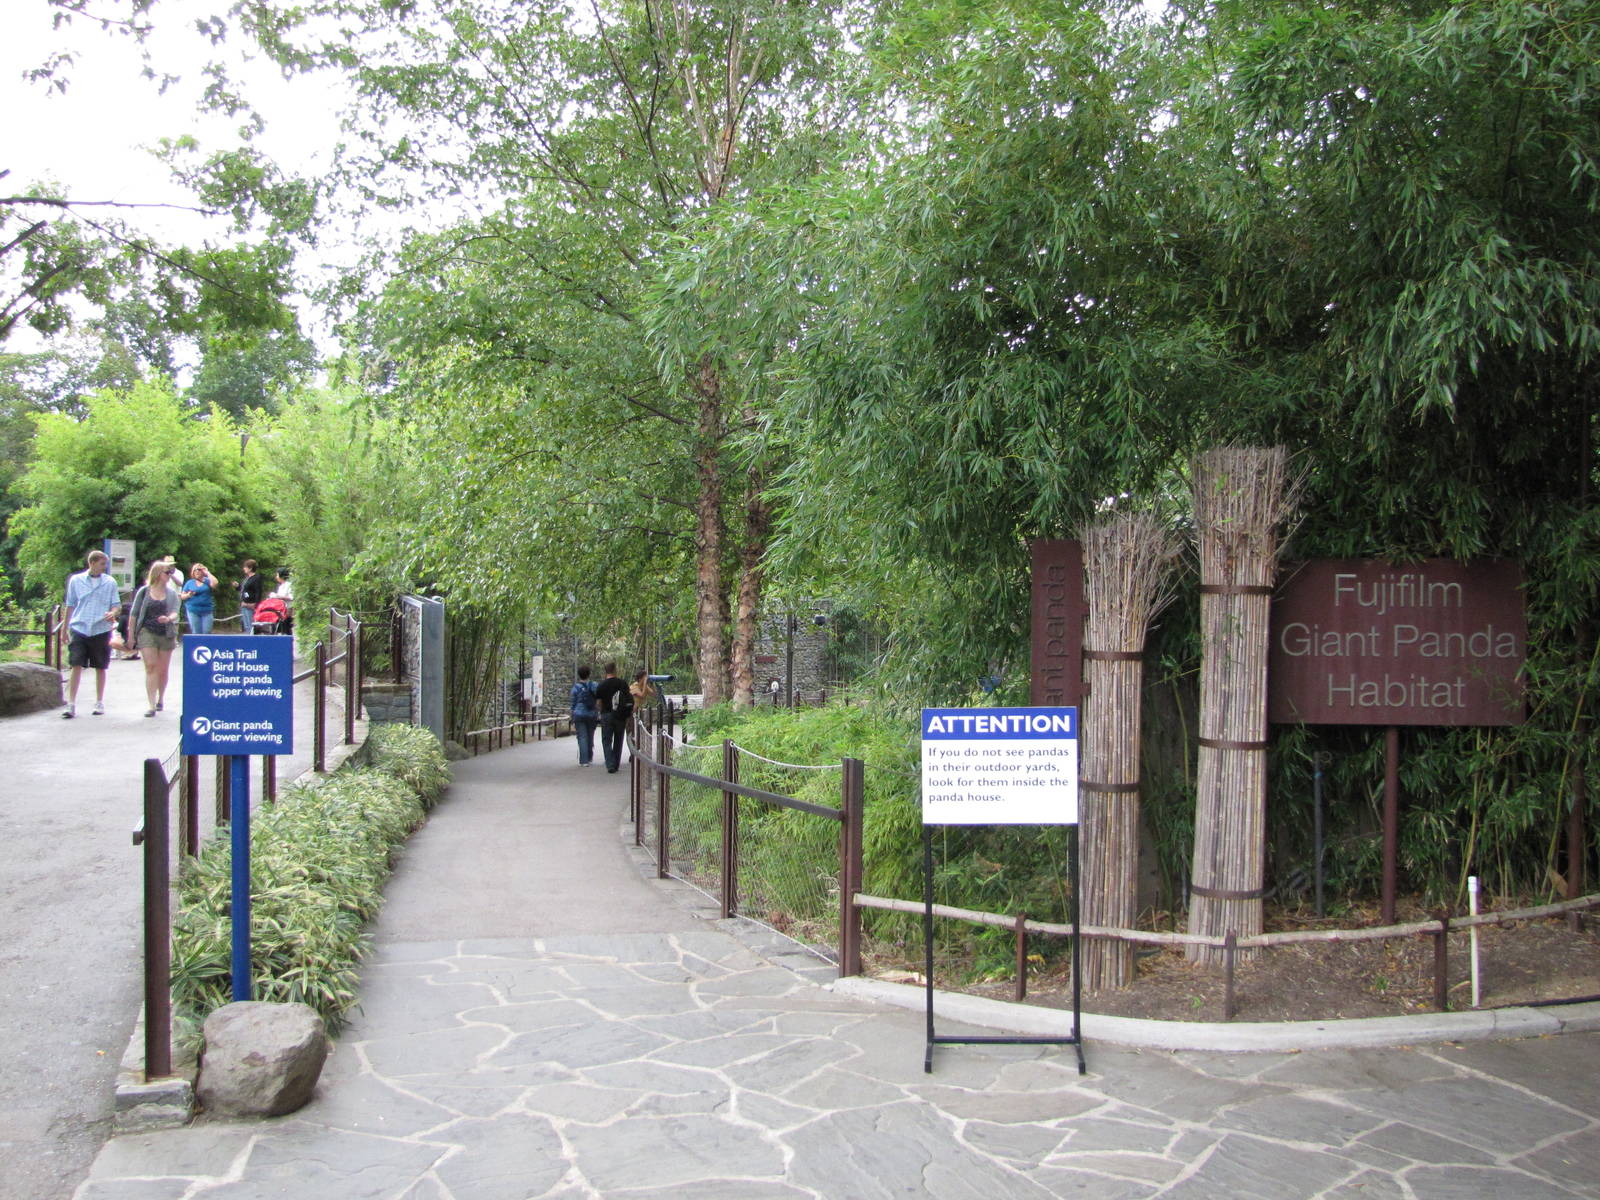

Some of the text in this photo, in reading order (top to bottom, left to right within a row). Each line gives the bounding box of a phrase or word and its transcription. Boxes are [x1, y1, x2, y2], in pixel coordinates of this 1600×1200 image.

[1334, 573, 1462, 616] Fujifilm
[1040, 565, 1069, 704] ant panda
[1280, 624, 1518, 658] Giant Panda
[213, 650, 257, 659] Asia Trail
[213, 662, 269, 671] Bird House
[212, 674, 272, 685] Giant panda
[213, 687, 282, 698] upper viewing
[1328, 674, 1466, 707] Habitat
[212, 720, 273, 731] Giant panda
[928, 715, 1070, 733] ATTENTION
[212, 732, 282, 744] lower viewing
[929, 748, 937, 756] If
[940, 748, 960, 758] you
[964, 747, 978, 756] do
[982, 748, 1001, 756] not
[1029, 747, 1069, 758] pandas
[929, 762, 1060, 773] in their outdoor yards,
[929, 778, 1068, 786] look for them inside the
[929, 793, 1004, 803] panda house.
